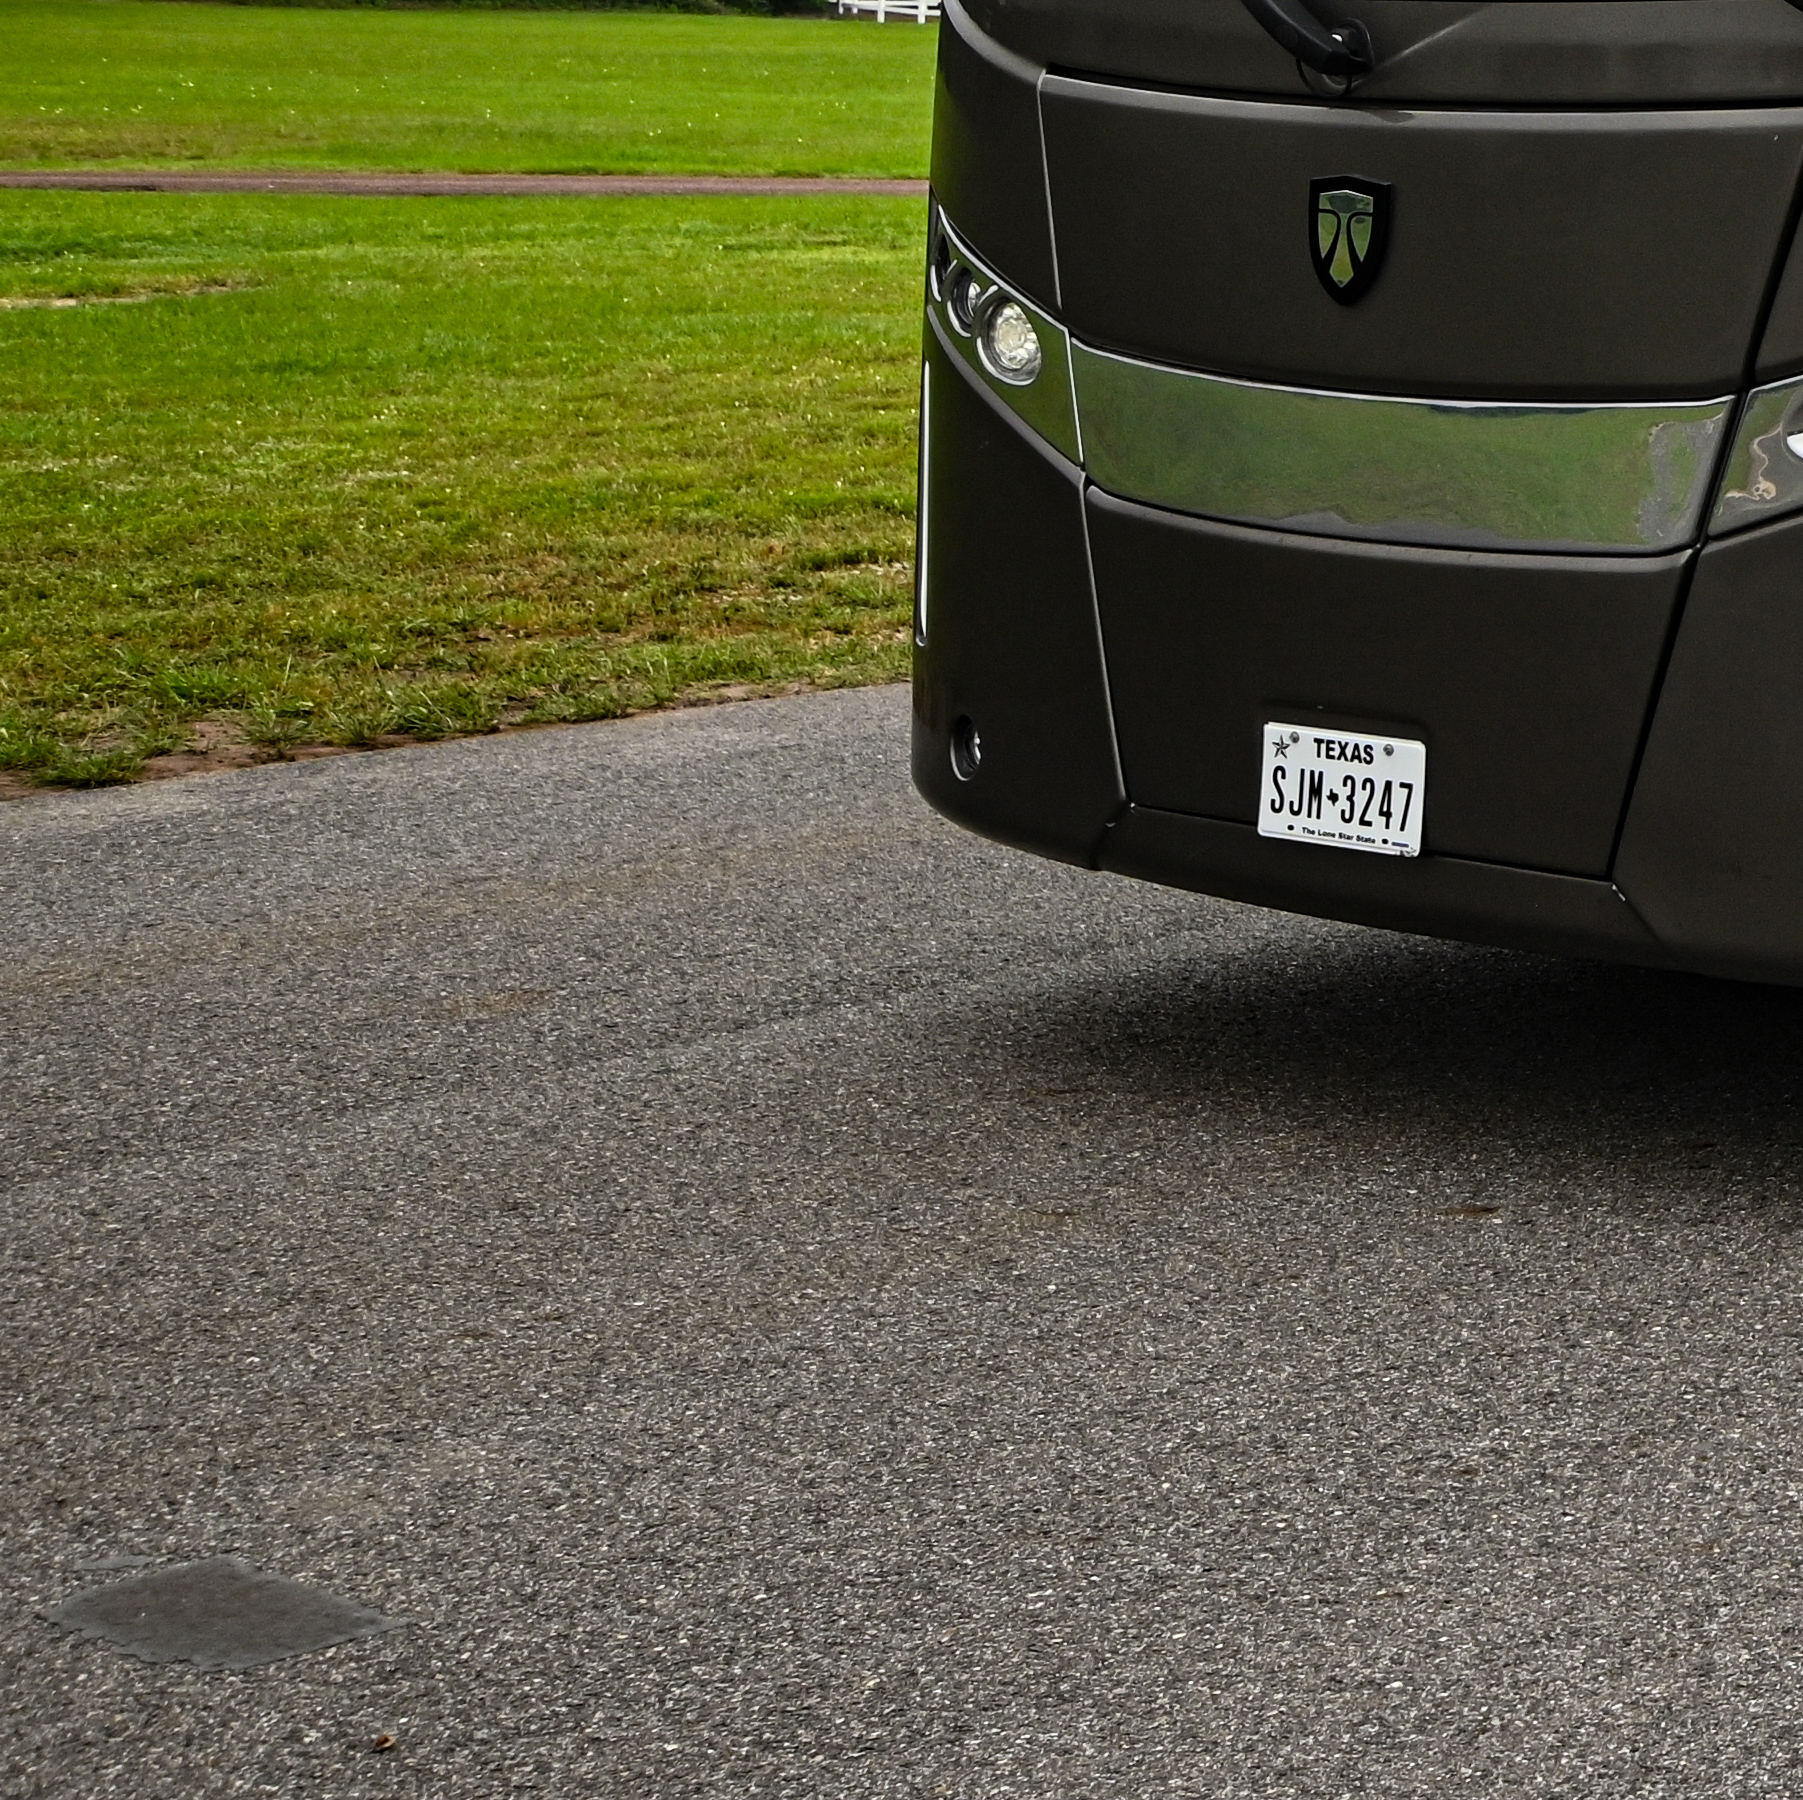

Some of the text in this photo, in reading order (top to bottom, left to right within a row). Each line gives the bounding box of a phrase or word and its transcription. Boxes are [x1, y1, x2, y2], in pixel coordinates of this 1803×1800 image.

[1313, 737, 1374, 765] TEXAS
[1301, 826, 1376, 844] The Lone Star State
